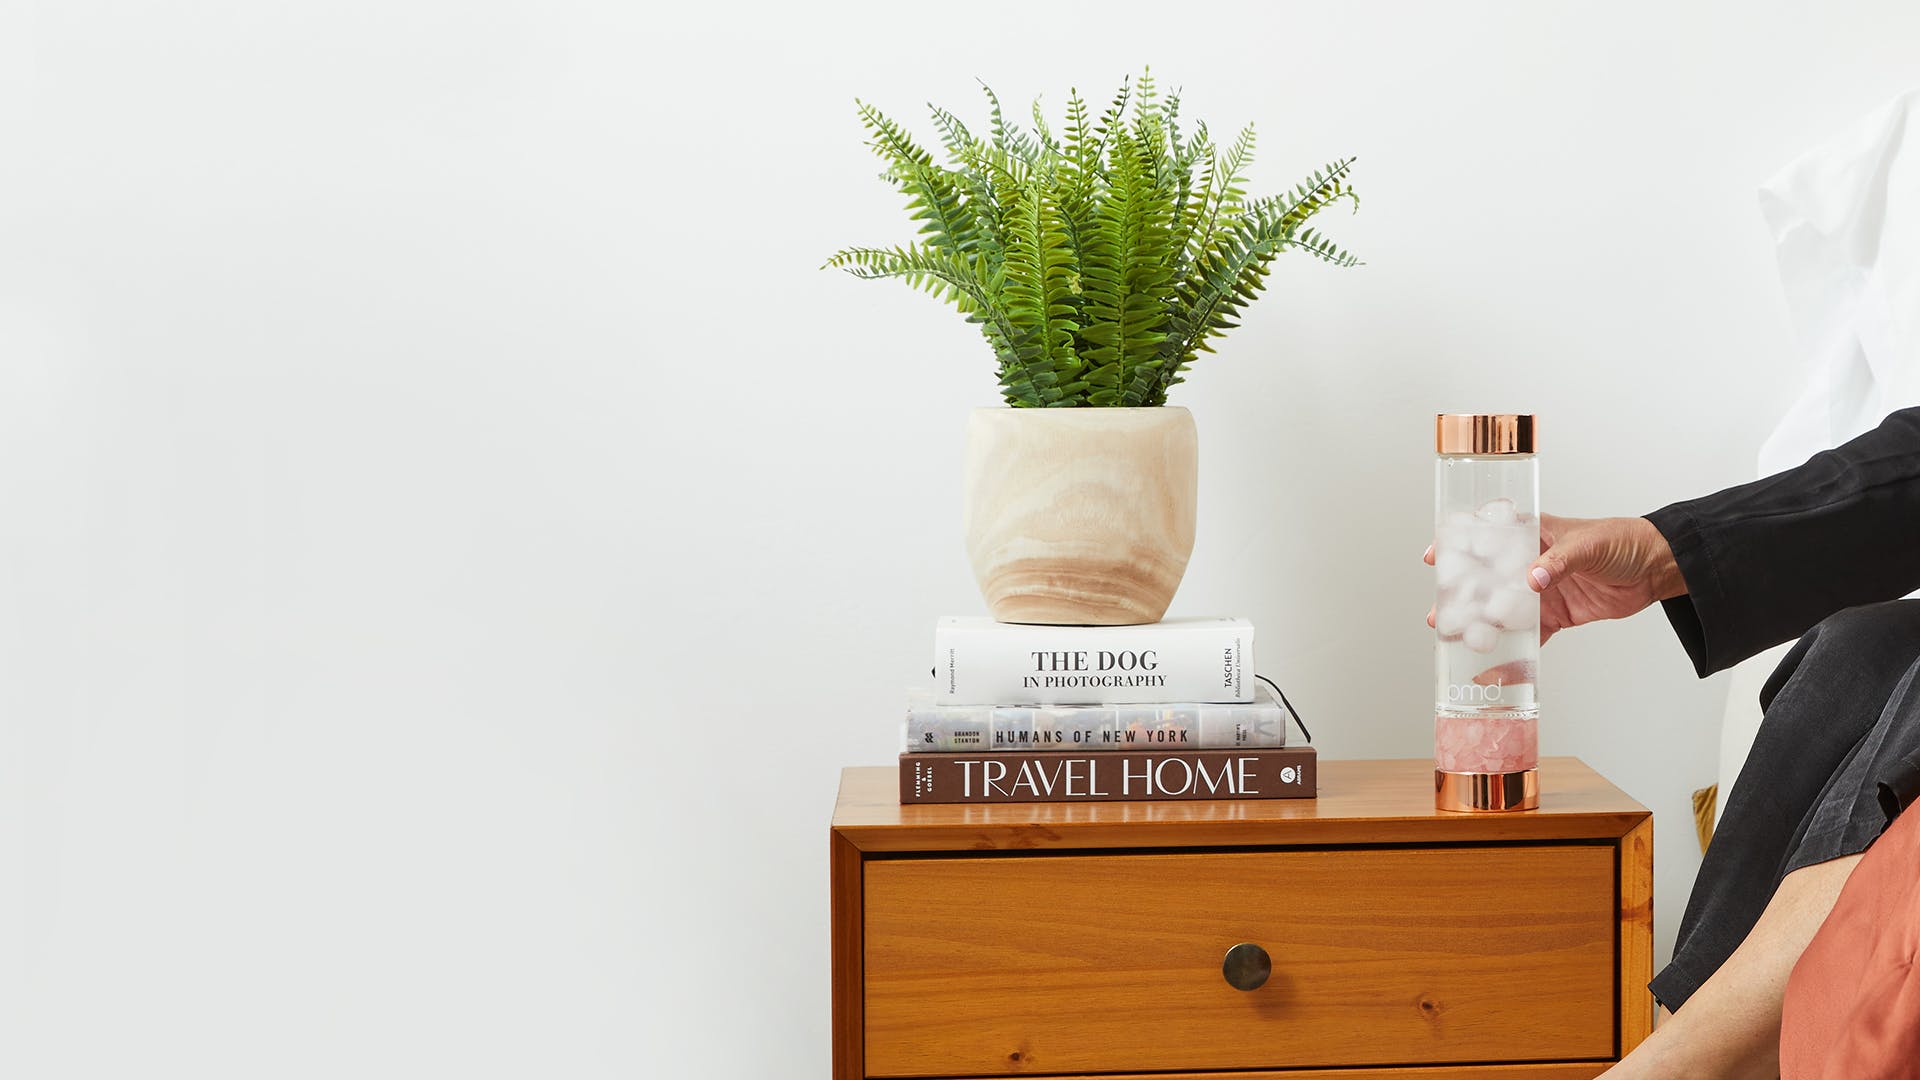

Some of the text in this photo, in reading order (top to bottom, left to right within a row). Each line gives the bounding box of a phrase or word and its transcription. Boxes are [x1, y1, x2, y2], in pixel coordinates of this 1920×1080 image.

[1031, 650, 1158, 671] THE DOG
[1224, 648, 1233, 688] TASCHEN
[1023, 675, 1167, 688] IN PHOTOGRAPHY
[996, 730, 1188, 743] HUMANS OF NEW YORK
[954, 757, 1259, 797] TRAVEL HOME
